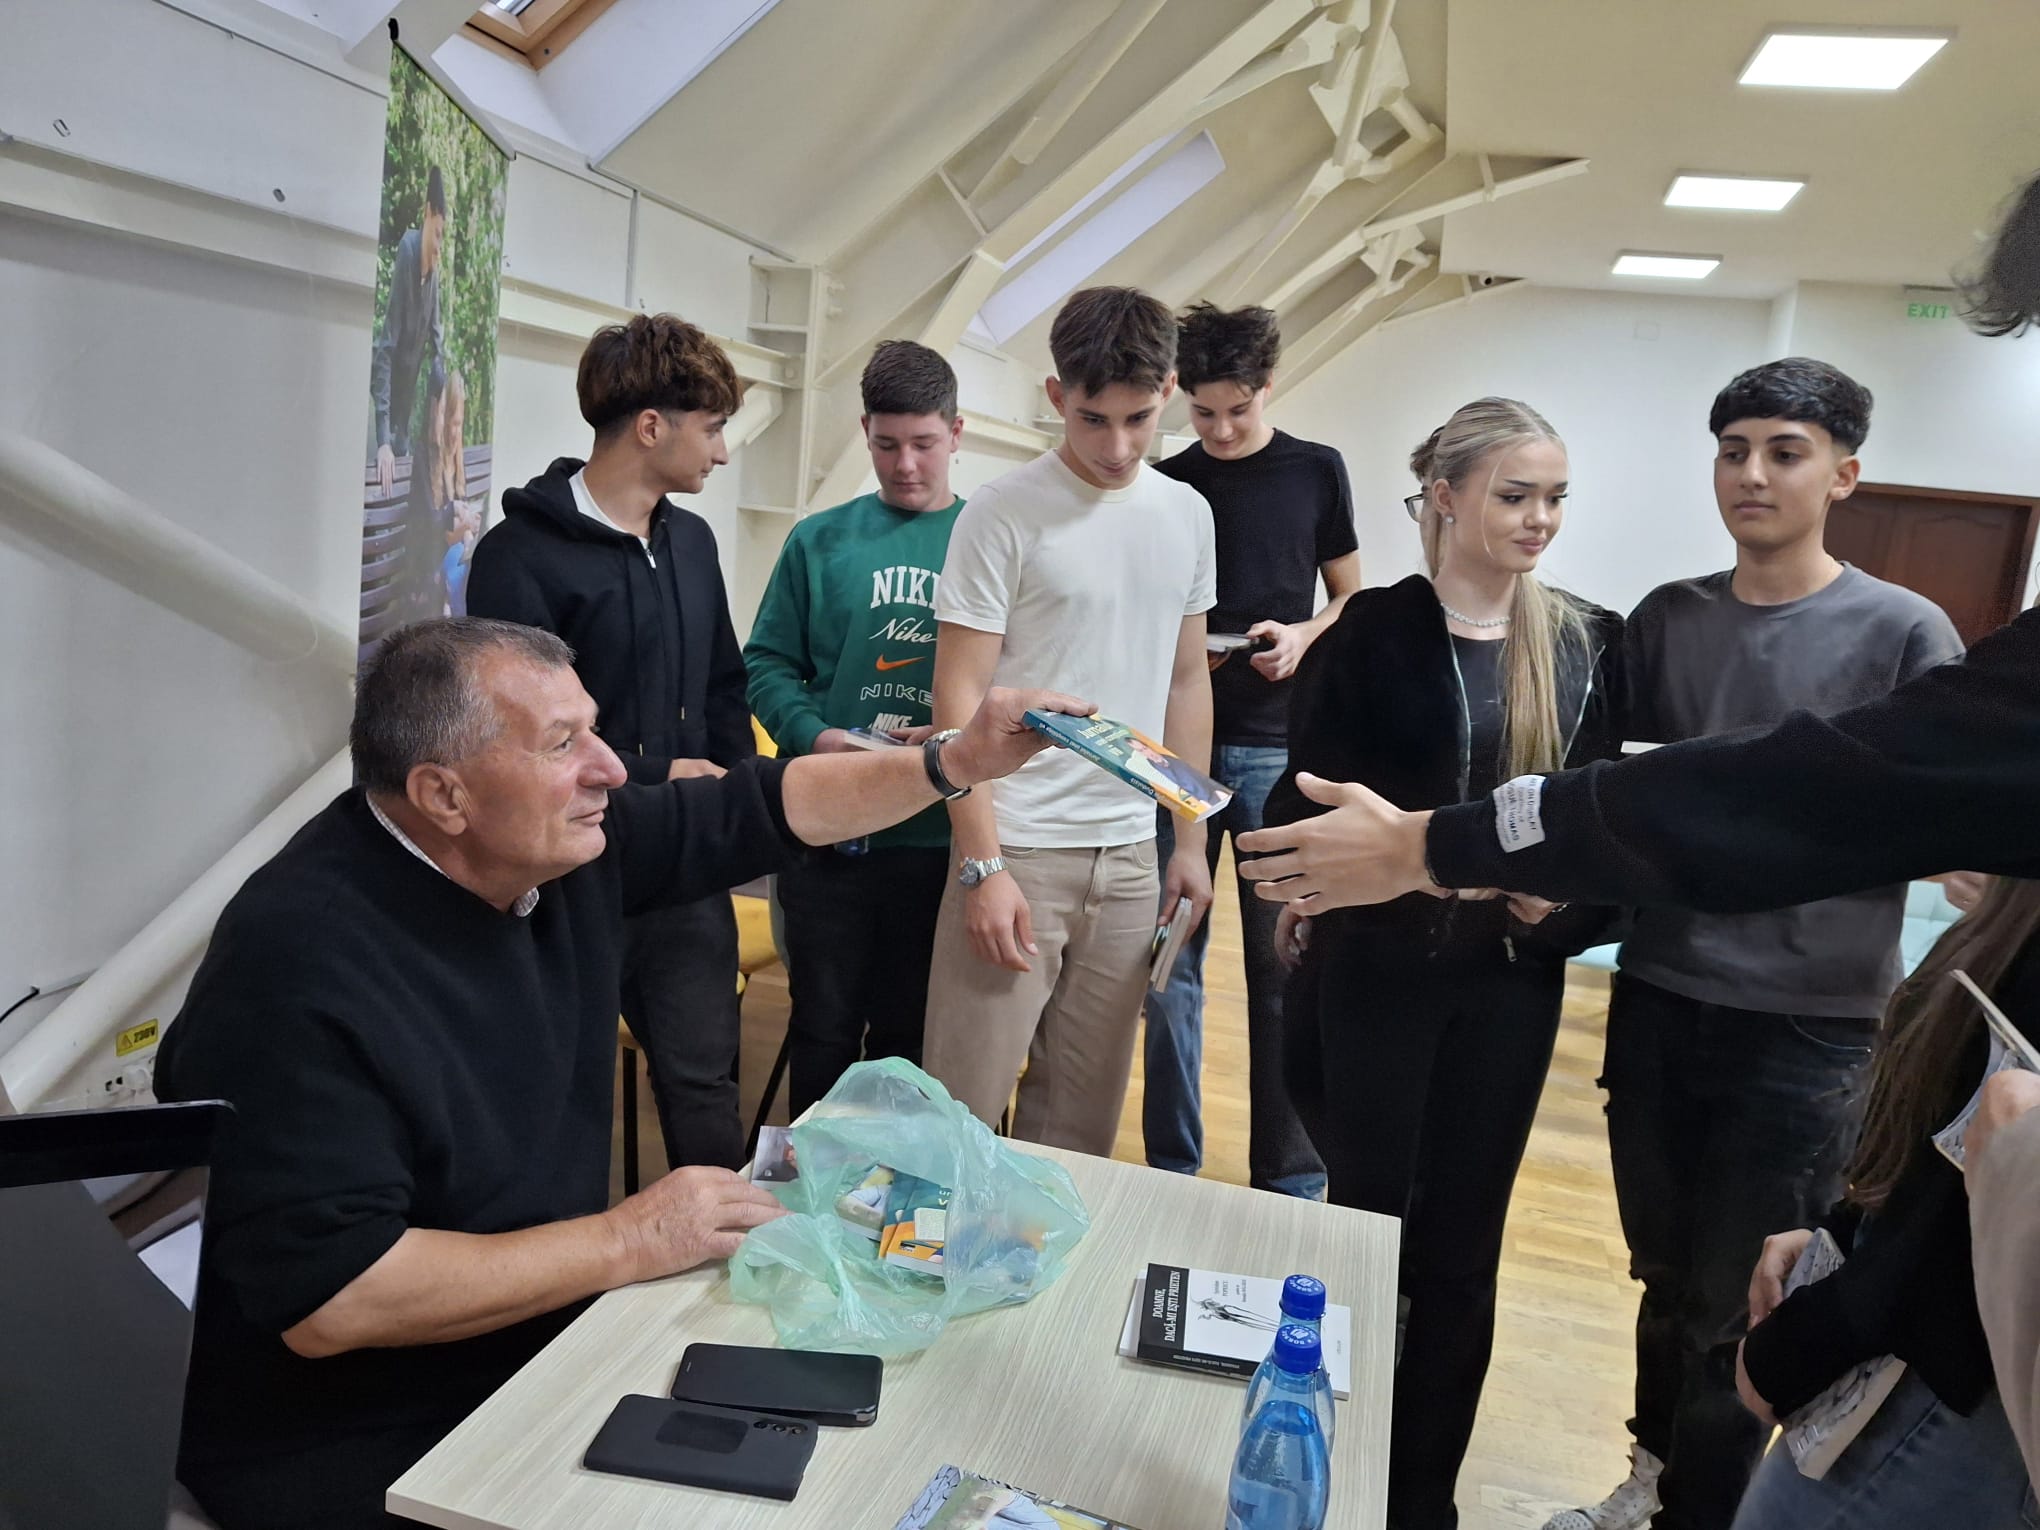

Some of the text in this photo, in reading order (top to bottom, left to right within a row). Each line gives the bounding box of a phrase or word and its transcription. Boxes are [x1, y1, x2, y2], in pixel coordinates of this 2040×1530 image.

[1907, 303, 1950, 319] EXIT
[868, 617, 938, 643] Nike
[872, 712, 912, 731] NIKE
[1168, 1270, 1181, 1297] PRIETEN
[1152, 1288, 1166, 1318] DOAMNE,
